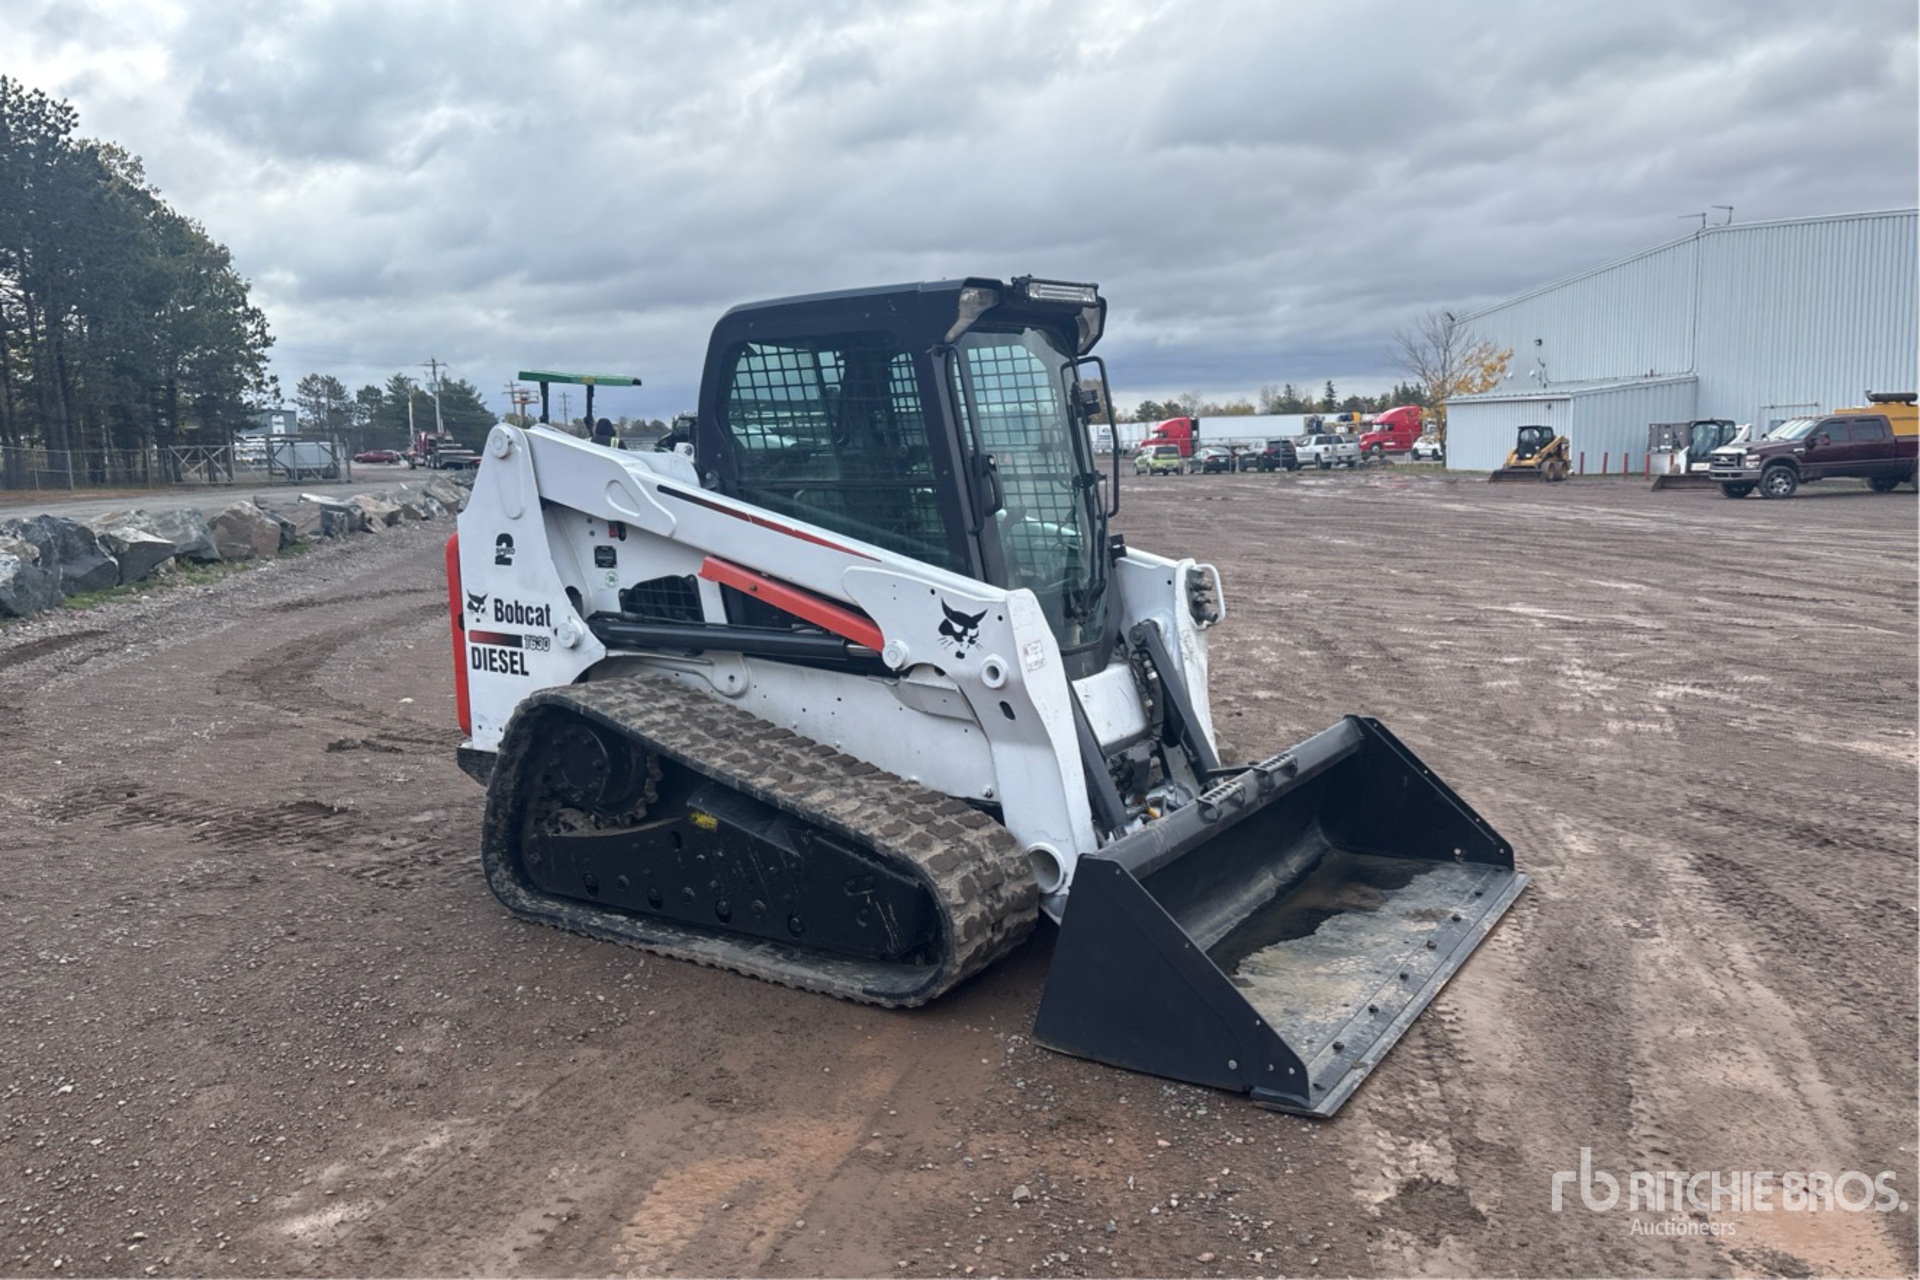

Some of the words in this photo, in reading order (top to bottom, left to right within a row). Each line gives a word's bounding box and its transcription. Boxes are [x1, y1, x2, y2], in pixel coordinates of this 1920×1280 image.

[495, 533, 514, 566] 2
[494, 598, 551, 627] Bobcat
[524, 634, 550, 651] T630
[471, 647, 530, 676] DIESEL
